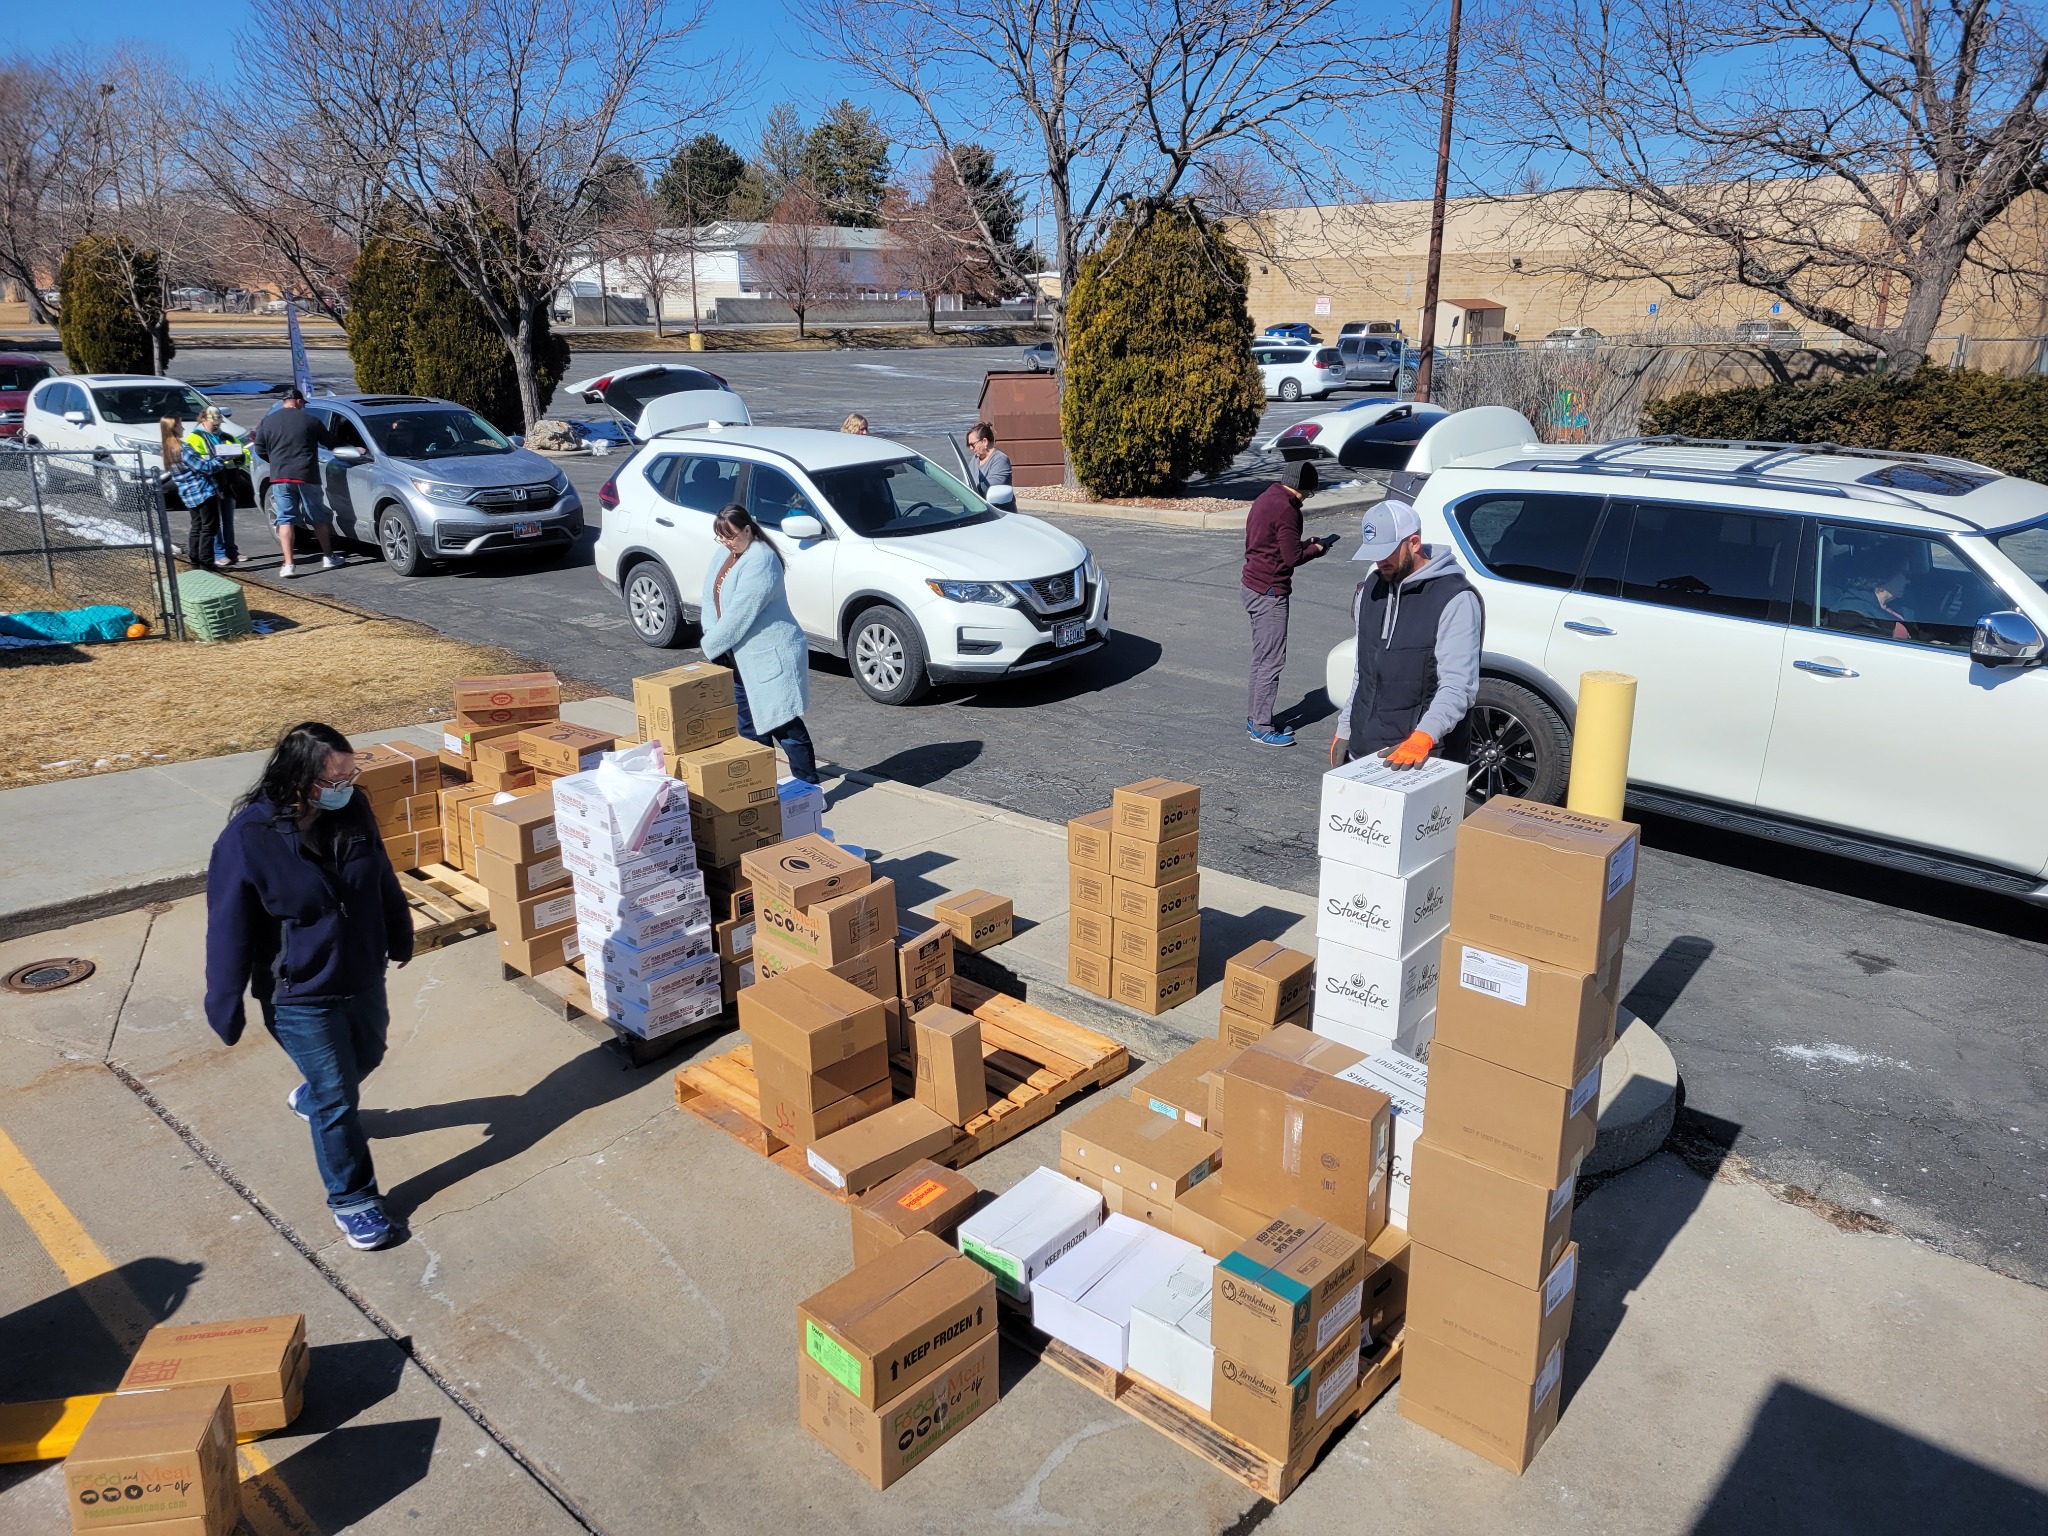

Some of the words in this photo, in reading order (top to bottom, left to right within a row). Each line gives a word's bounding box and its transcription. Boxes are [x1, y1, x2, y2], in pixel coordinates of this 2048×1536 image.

[1415, 806, 1452, 841] Stonefire
[1506, 807, 1563, 824] FROZEN
[1564, 814, 1610, 828] STORE
[1566, 823, 1604, 833] KEEP
[1328, 814, 1391, 845] Stonefire
[1326, 898, 1391, 929] Stonefire
[1413, 886, 1445, 923] Stonefire
[940, 929, 951, 939] 442
[1325, 977, 1389, 1007] Stonefire
[1373, 1057, 1413, 1080] WITHOUT
[1395, 1059, 1421, 1073] CODE
[1347, 1072, 1376, 1090] SHELF
[1256, 1232, 1269, 1242] KEEP
[1266, 1219, 1286, 1233] FROZEN
[1044, 1249, 1061, 1268] KEEP
[1062, 1229, 1088, 1252] FROZEN
[1238, 1287, 1277, 1314] Brakebush
[175, 1327, 243, 1341] REFRIGERATED
[903, 1341, 931, 1370] KEEP
[933, 1314, 973, 1351] FROZEN
[1238, 1367, 1277, 1395] Brakebush
[894, 1396, 936, 1435] Food
[947, 1355, 986, 1396] Meat
[70, 1471, 122, 1490] Food
[123, 1472, 138, 1482] and
[138, 1464, 193, 1482] Meat
[146, 1480, 193, 1496] co-op
